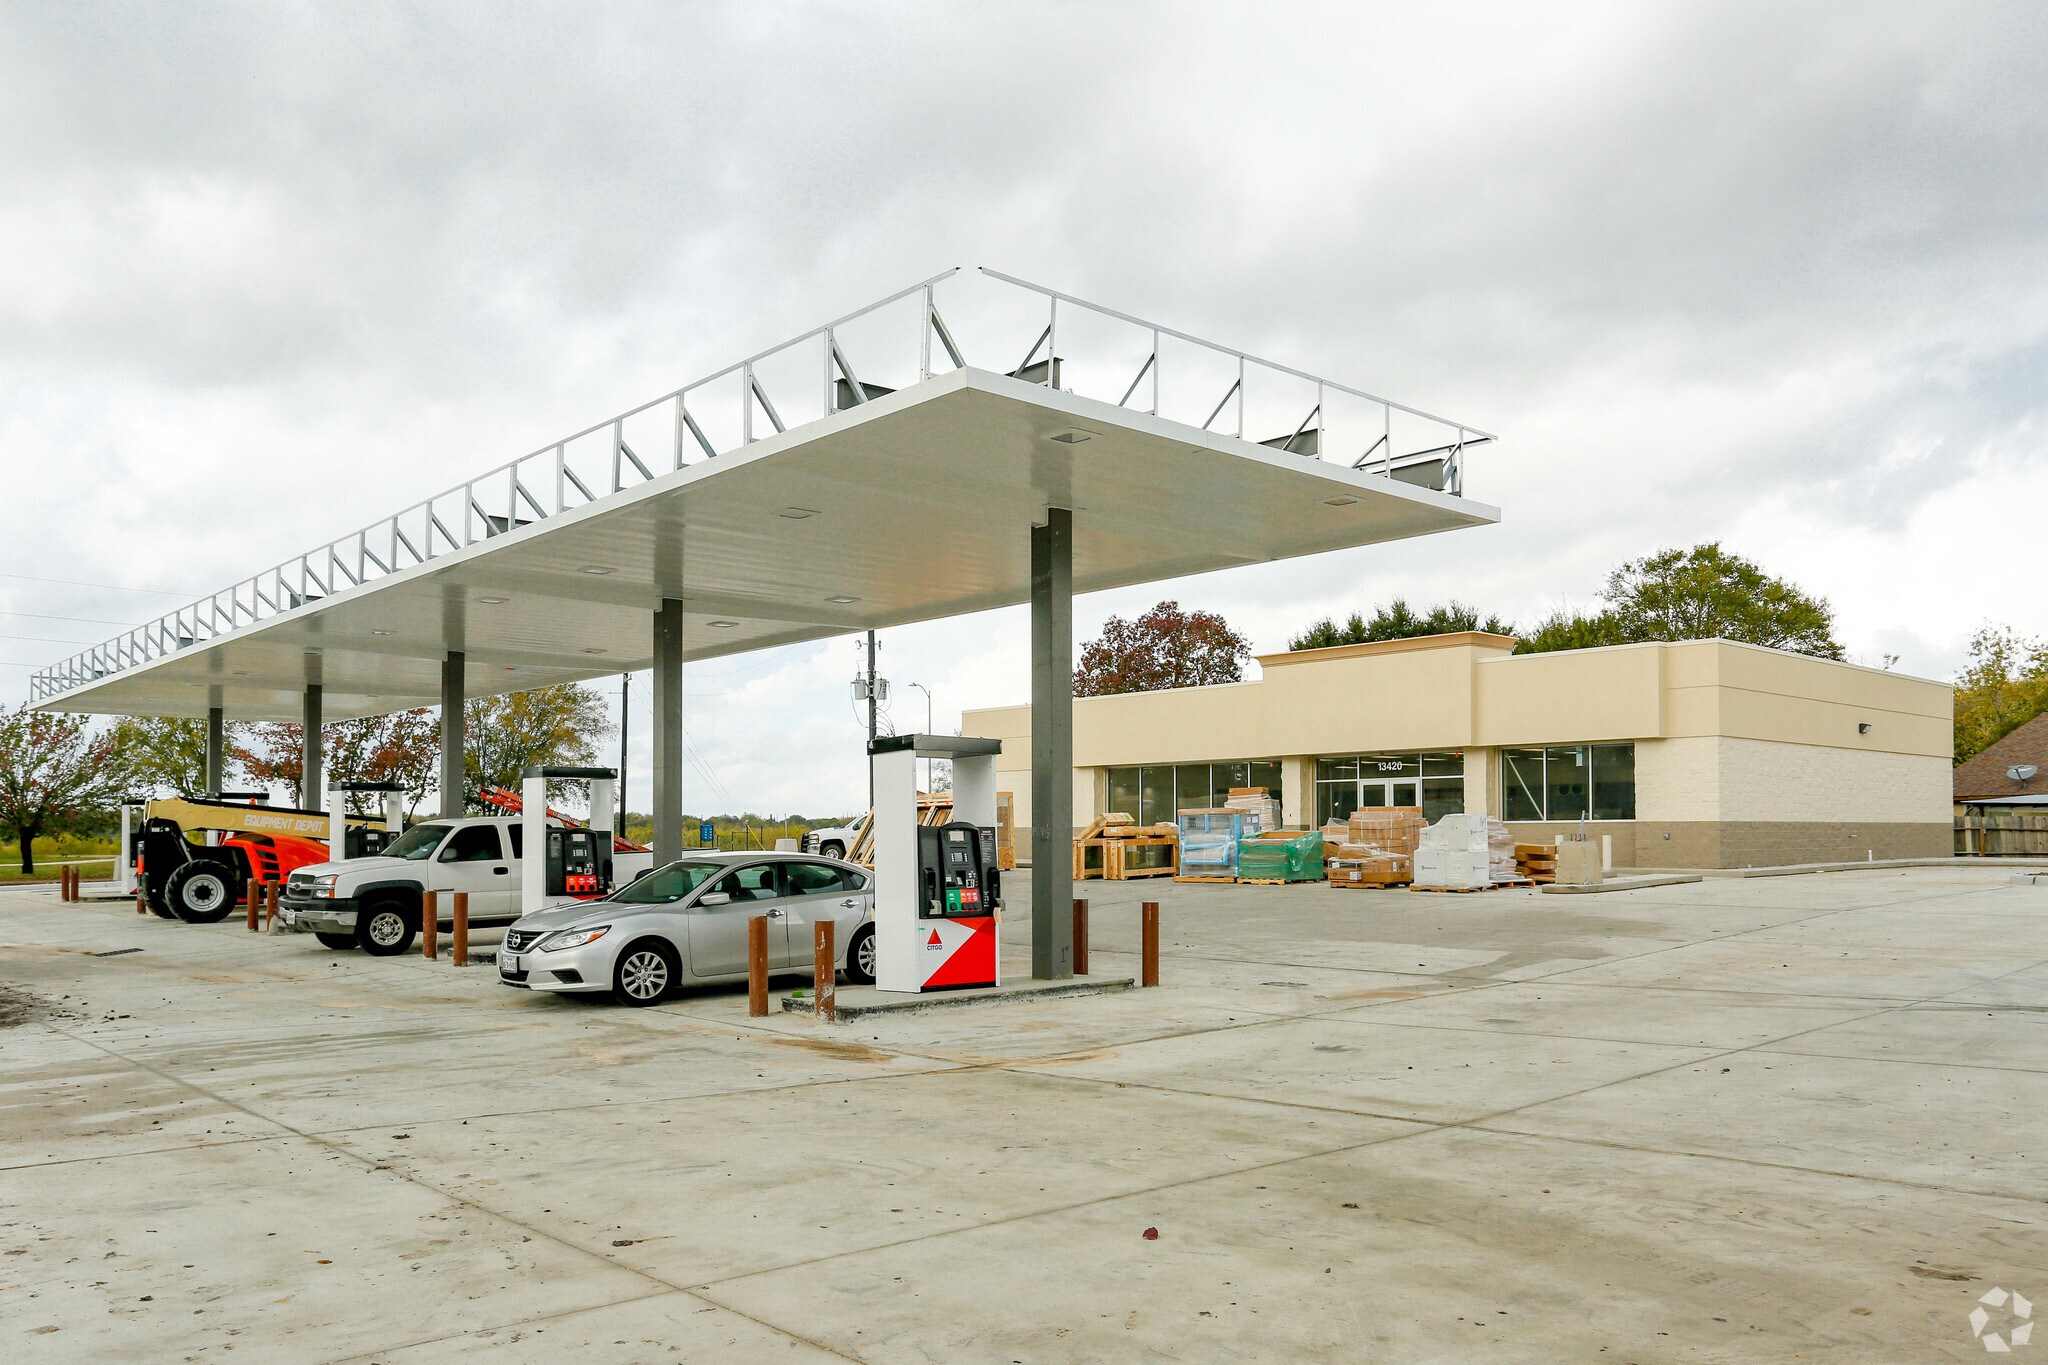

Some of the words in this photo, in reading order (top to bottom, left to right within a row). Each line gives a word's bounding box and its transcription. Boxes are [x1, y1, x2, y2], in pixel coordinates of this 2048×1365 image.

[1378, 761, 1403, 771] 13420
[243, 814, 294, 830] EQUIPMENT
[294, 819, 325, 833] DEPOT
